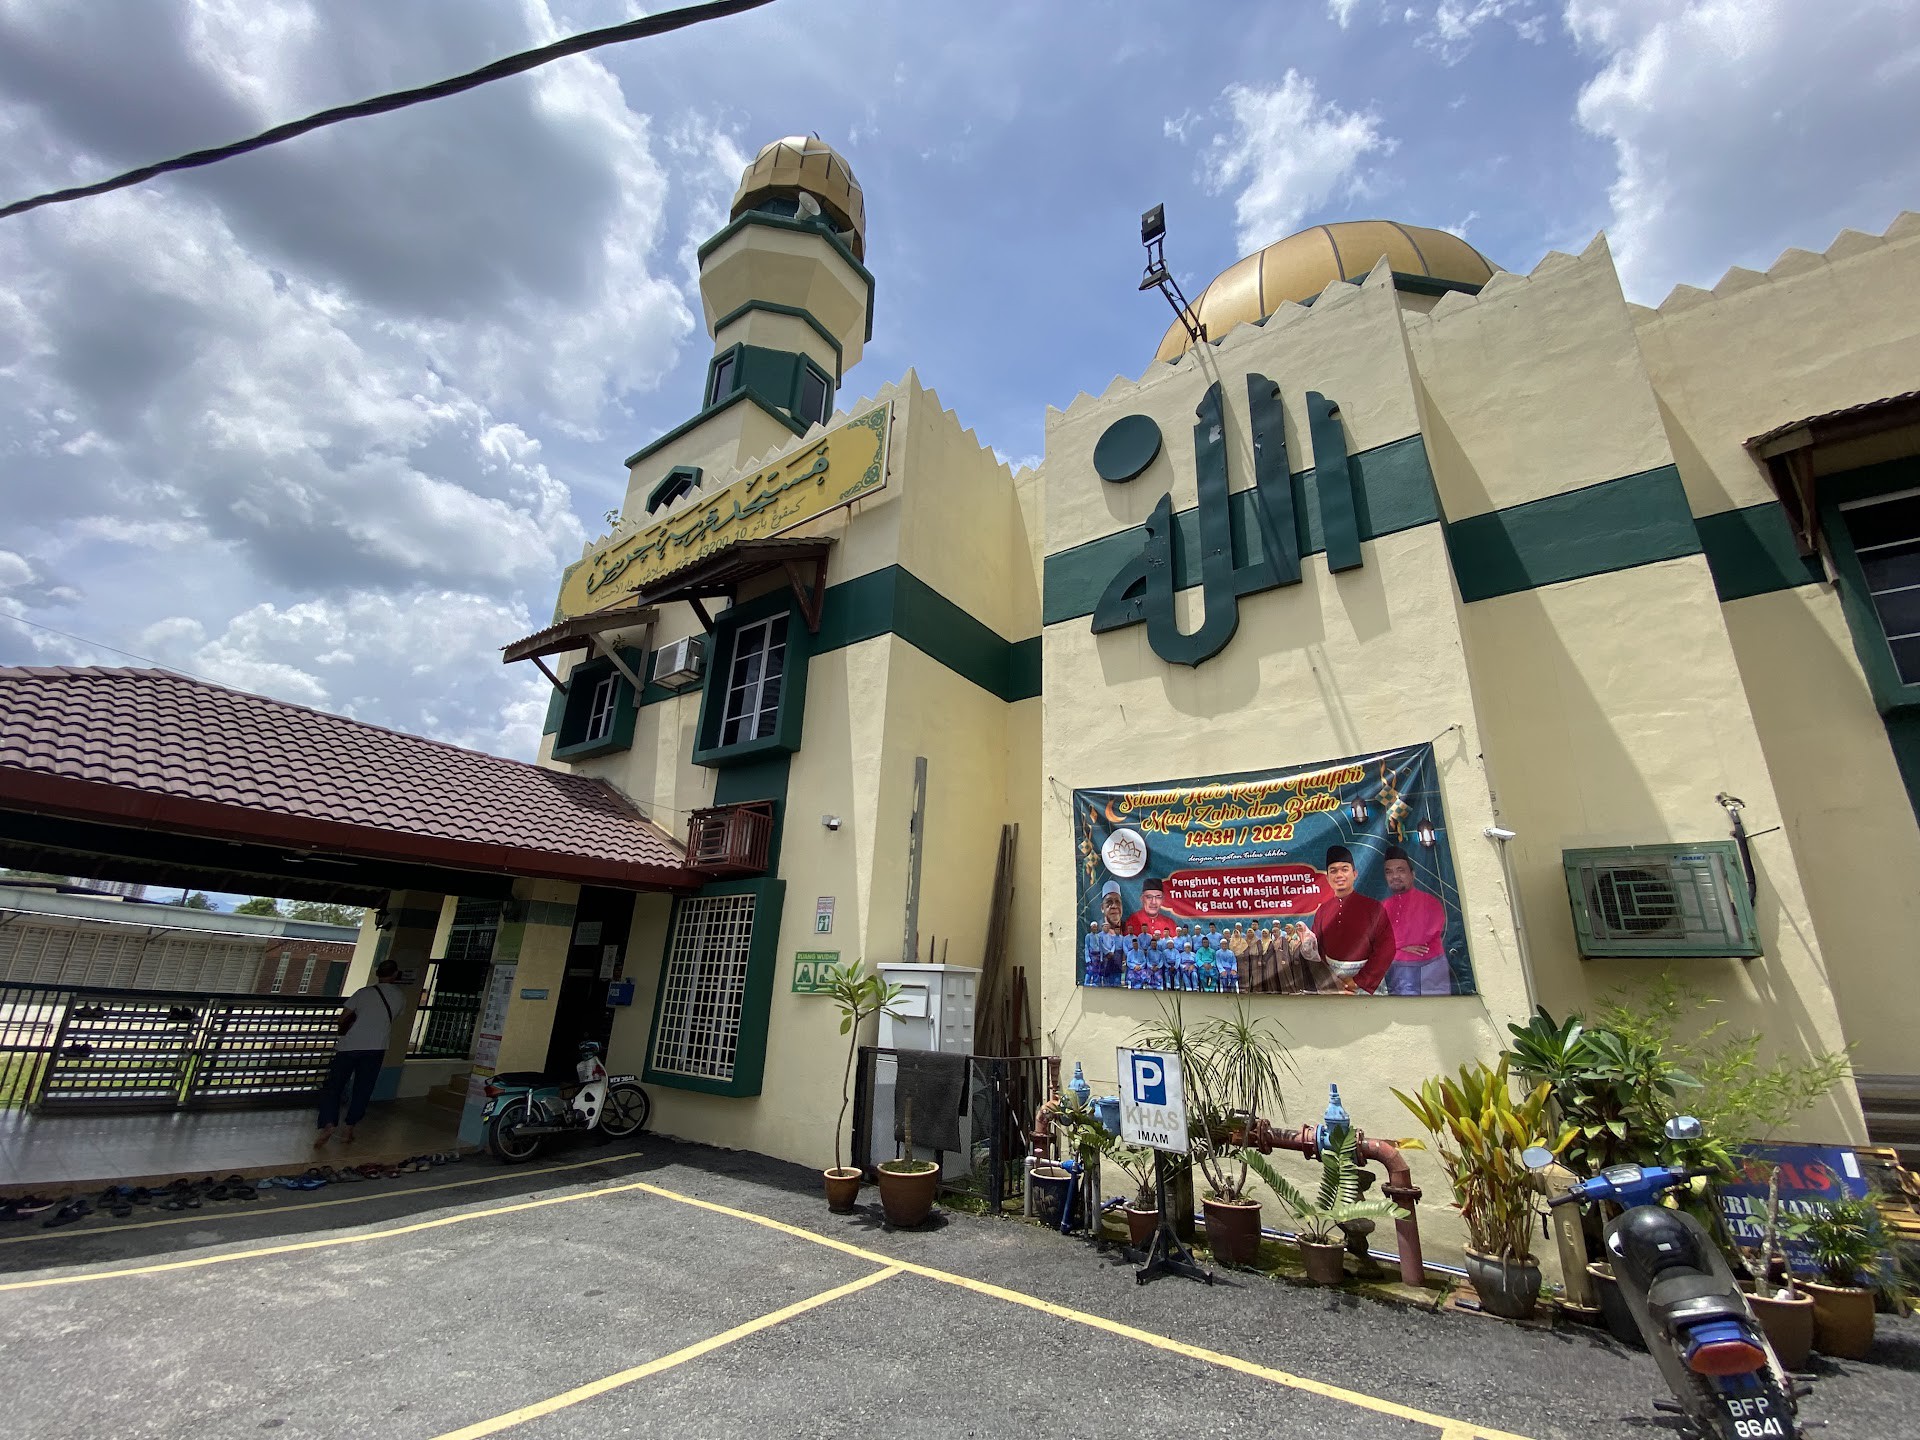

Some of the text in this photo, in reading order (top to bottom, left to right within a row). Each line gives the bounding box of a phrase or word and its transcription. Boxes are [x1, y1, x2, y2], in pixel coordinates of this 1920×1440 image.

[1119, 788, 1181, 812] Selamat
[1183, 783, 1228, 805] Hari
[1229, 780, 1281, 804] Raya
[1141, 793, 1341, 834] Maaf Zahir dan Batin
[1184, 823, 1295, 848] 1443H / 2022
[1188, 854, 1214, 864] dengan
[1243, 851, 1264, 859] tulus
[1172, 872, 1315, 888] Penghulu, Ketua Kampung,
[1170, 884, 1321, 899] Tn Nazir & AJK Masjid Kariah
[1195, 899, 1293, 912] Kg Batu 10, Cheras
[1134, 1059, 1163, 1100] P
[1125, 1105, 1180, 1131] KHAS
[1137, 1130, 1169, 1144] IMAM
[1726, 1396, 1770, 1417] BFP
[1734, 1417, 1784, 1438] 8641
